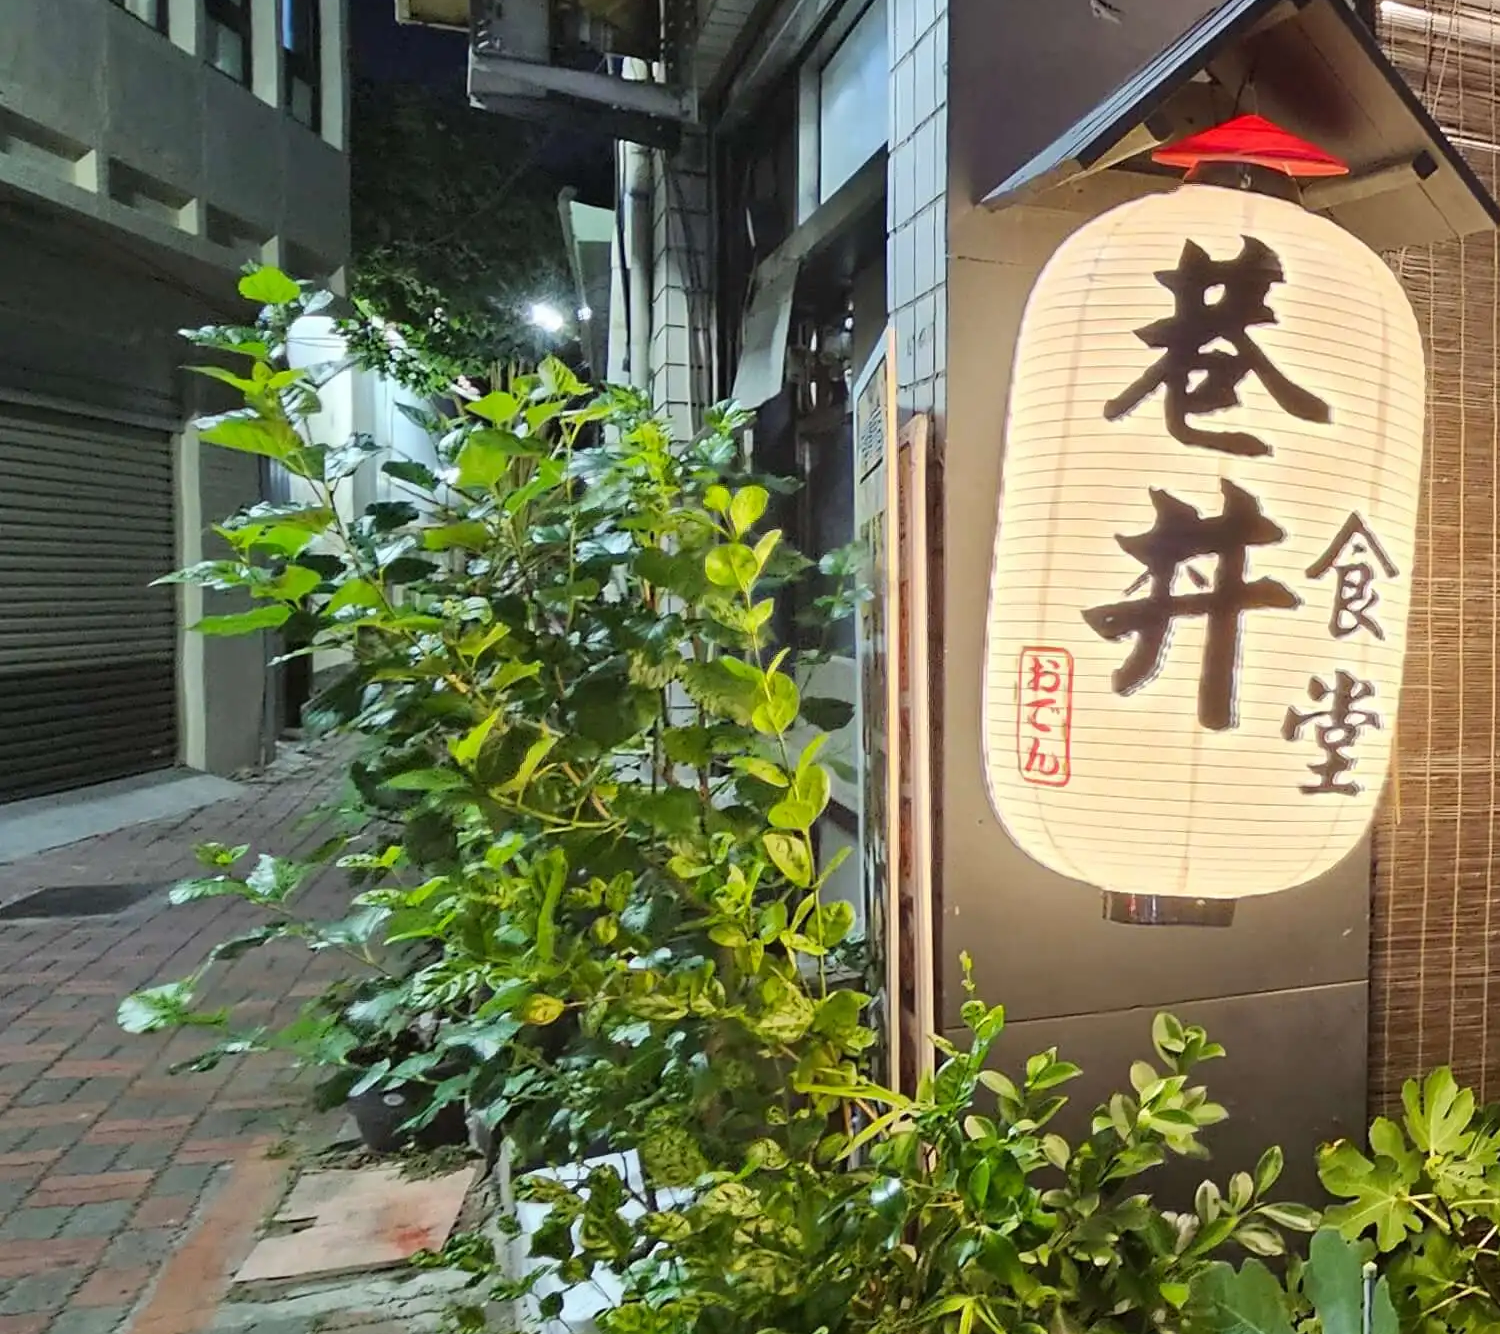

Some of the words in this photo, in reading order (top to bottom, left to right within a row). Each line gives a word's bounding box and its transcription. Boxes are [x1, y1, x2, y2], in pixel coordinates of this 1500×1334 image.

[1024, 656, 1061, 776] おでん
[1281, 510, 1400, 796] 食堂
